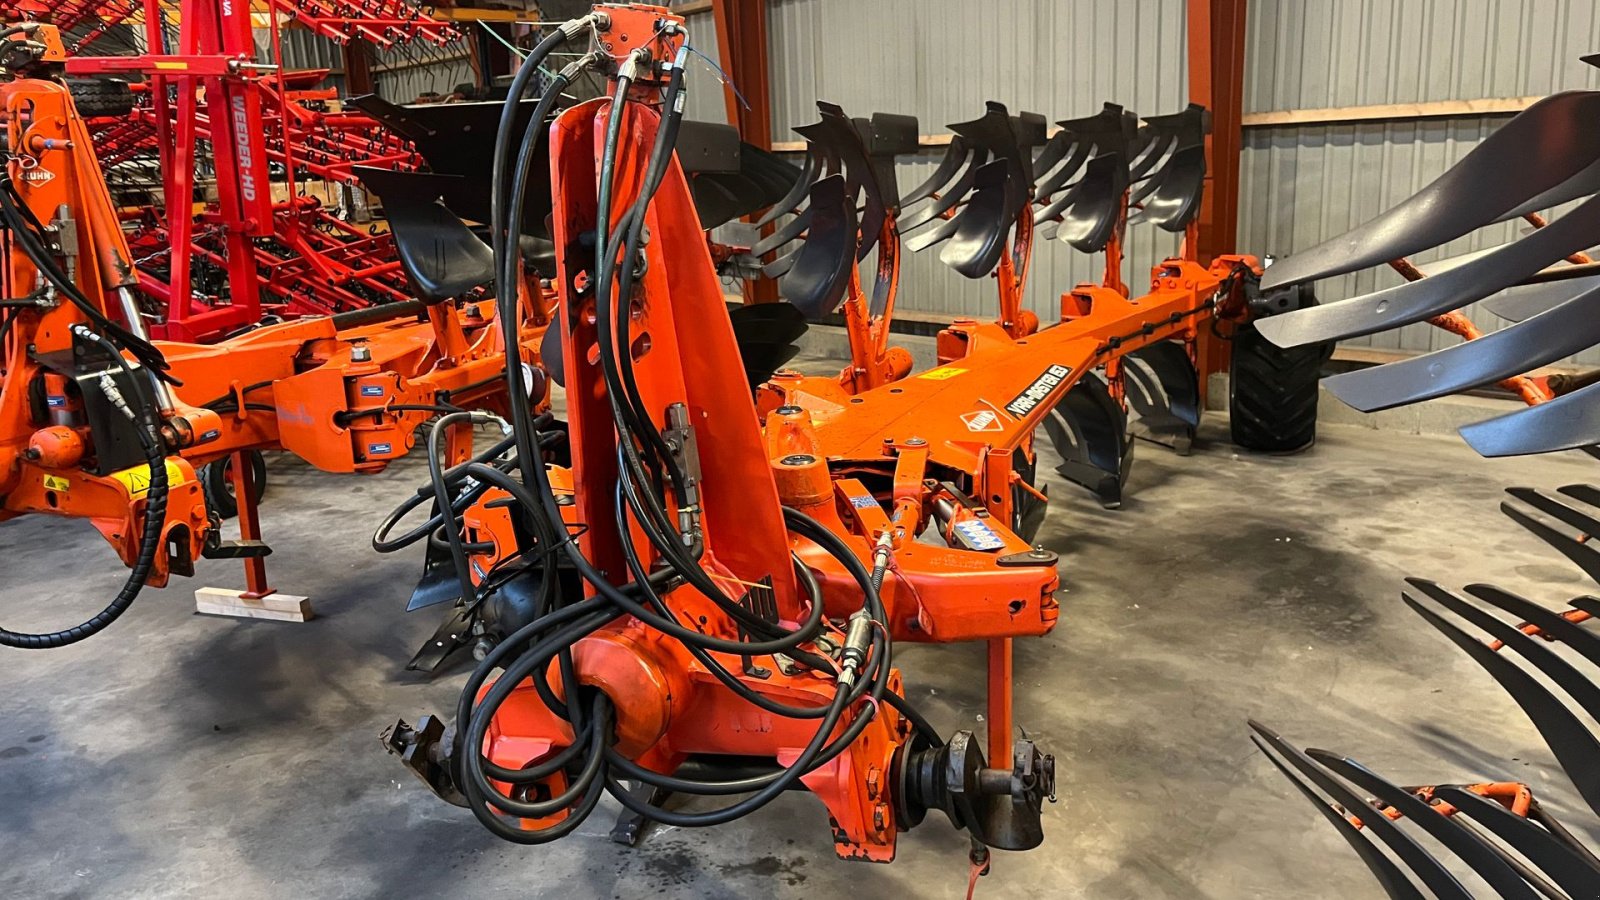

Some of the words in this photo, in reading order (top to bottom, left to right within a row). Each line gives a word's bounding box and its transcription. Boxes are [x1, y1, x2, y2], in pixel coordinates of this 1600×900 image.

[223, 0, 232, 16] VA
[232, 95, 256, 201] WEEDER-HD
[1006, 373, 1061, 415] VARI-MASTER
